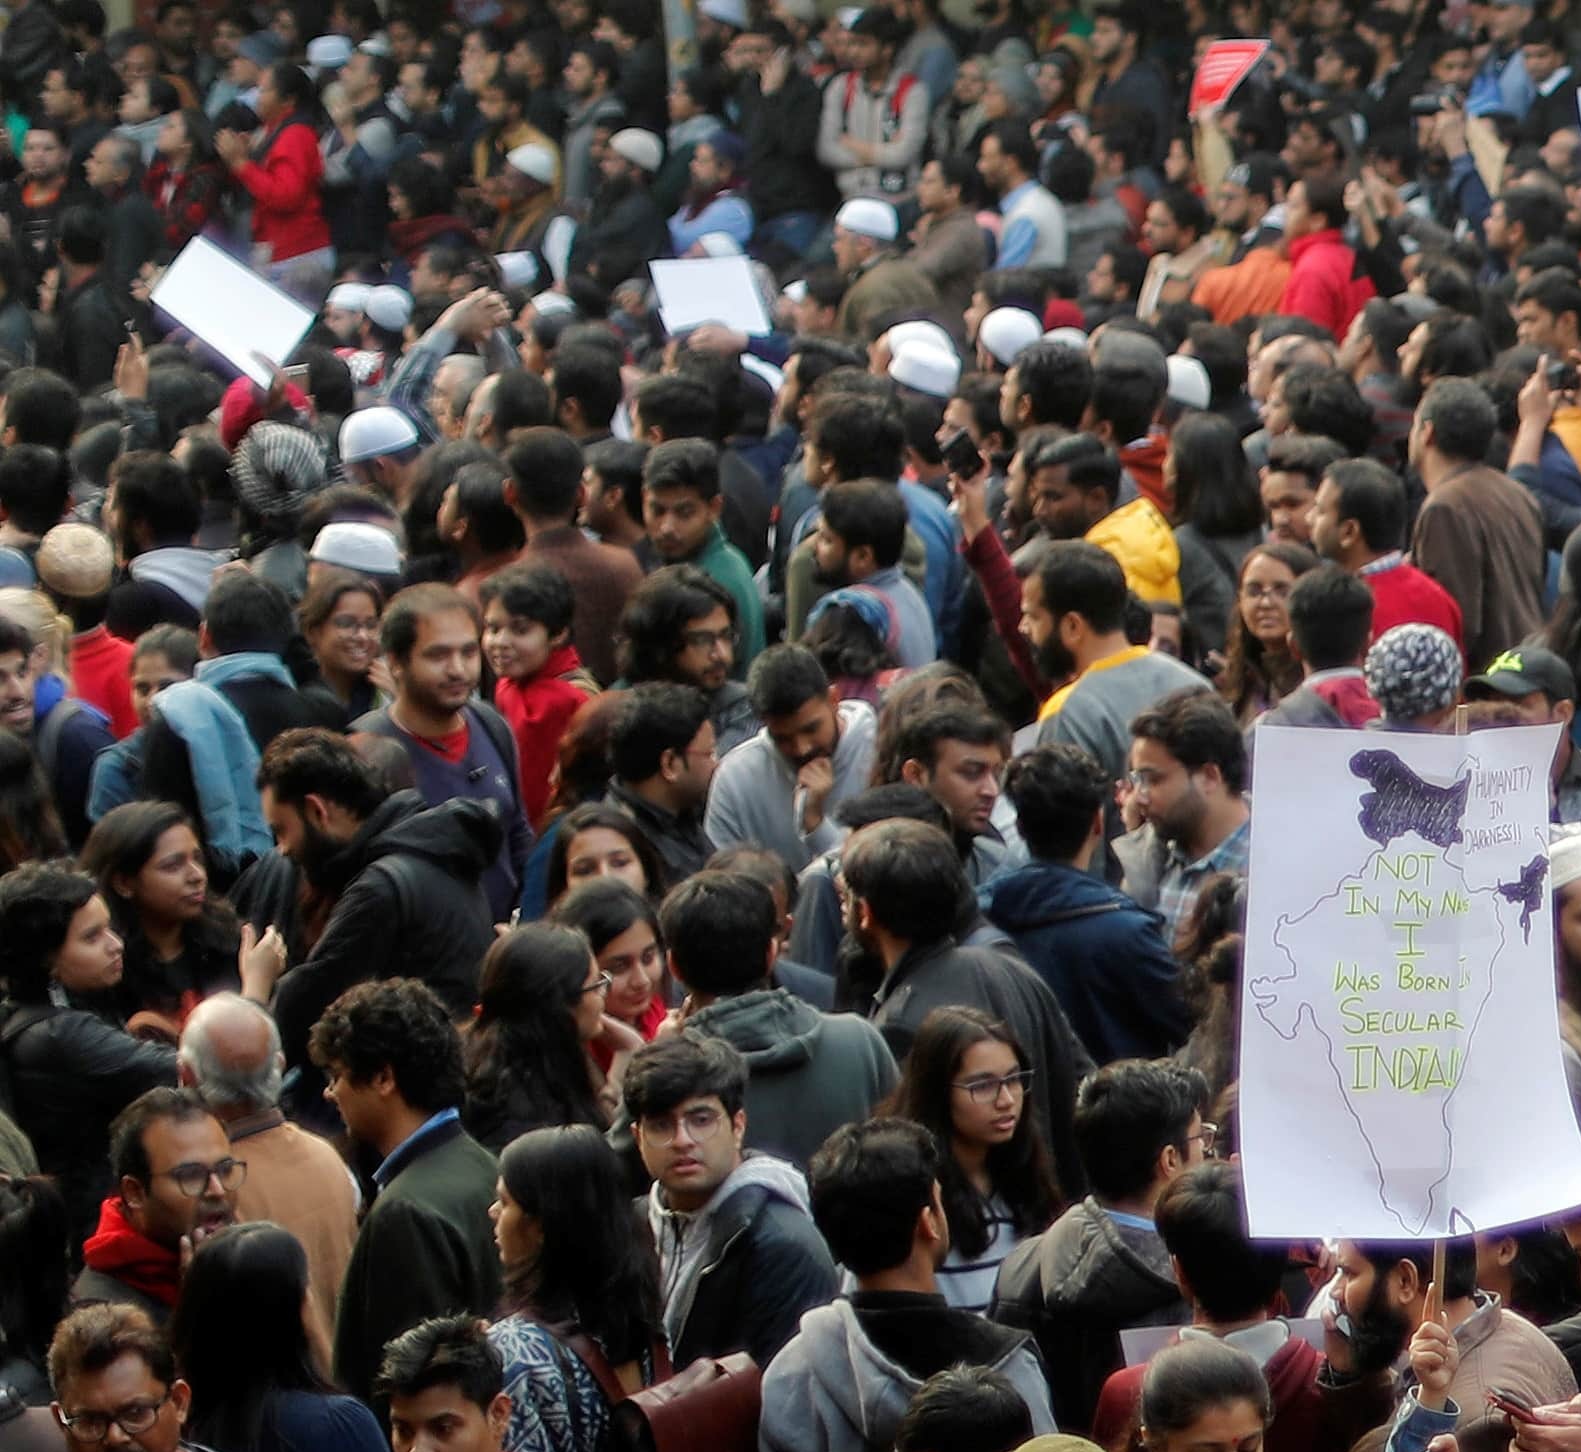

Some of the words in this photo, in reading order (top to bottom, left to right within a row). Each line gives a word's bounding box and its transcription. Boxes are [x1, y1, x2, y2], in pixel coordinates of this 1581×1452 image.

[1474, 765, 1534, 800] HUMANITY
[1489, 800, 1505, 821] IN
[1374, 853, 1437, 888] NOT
[1394, 922, 1426, 956] I
